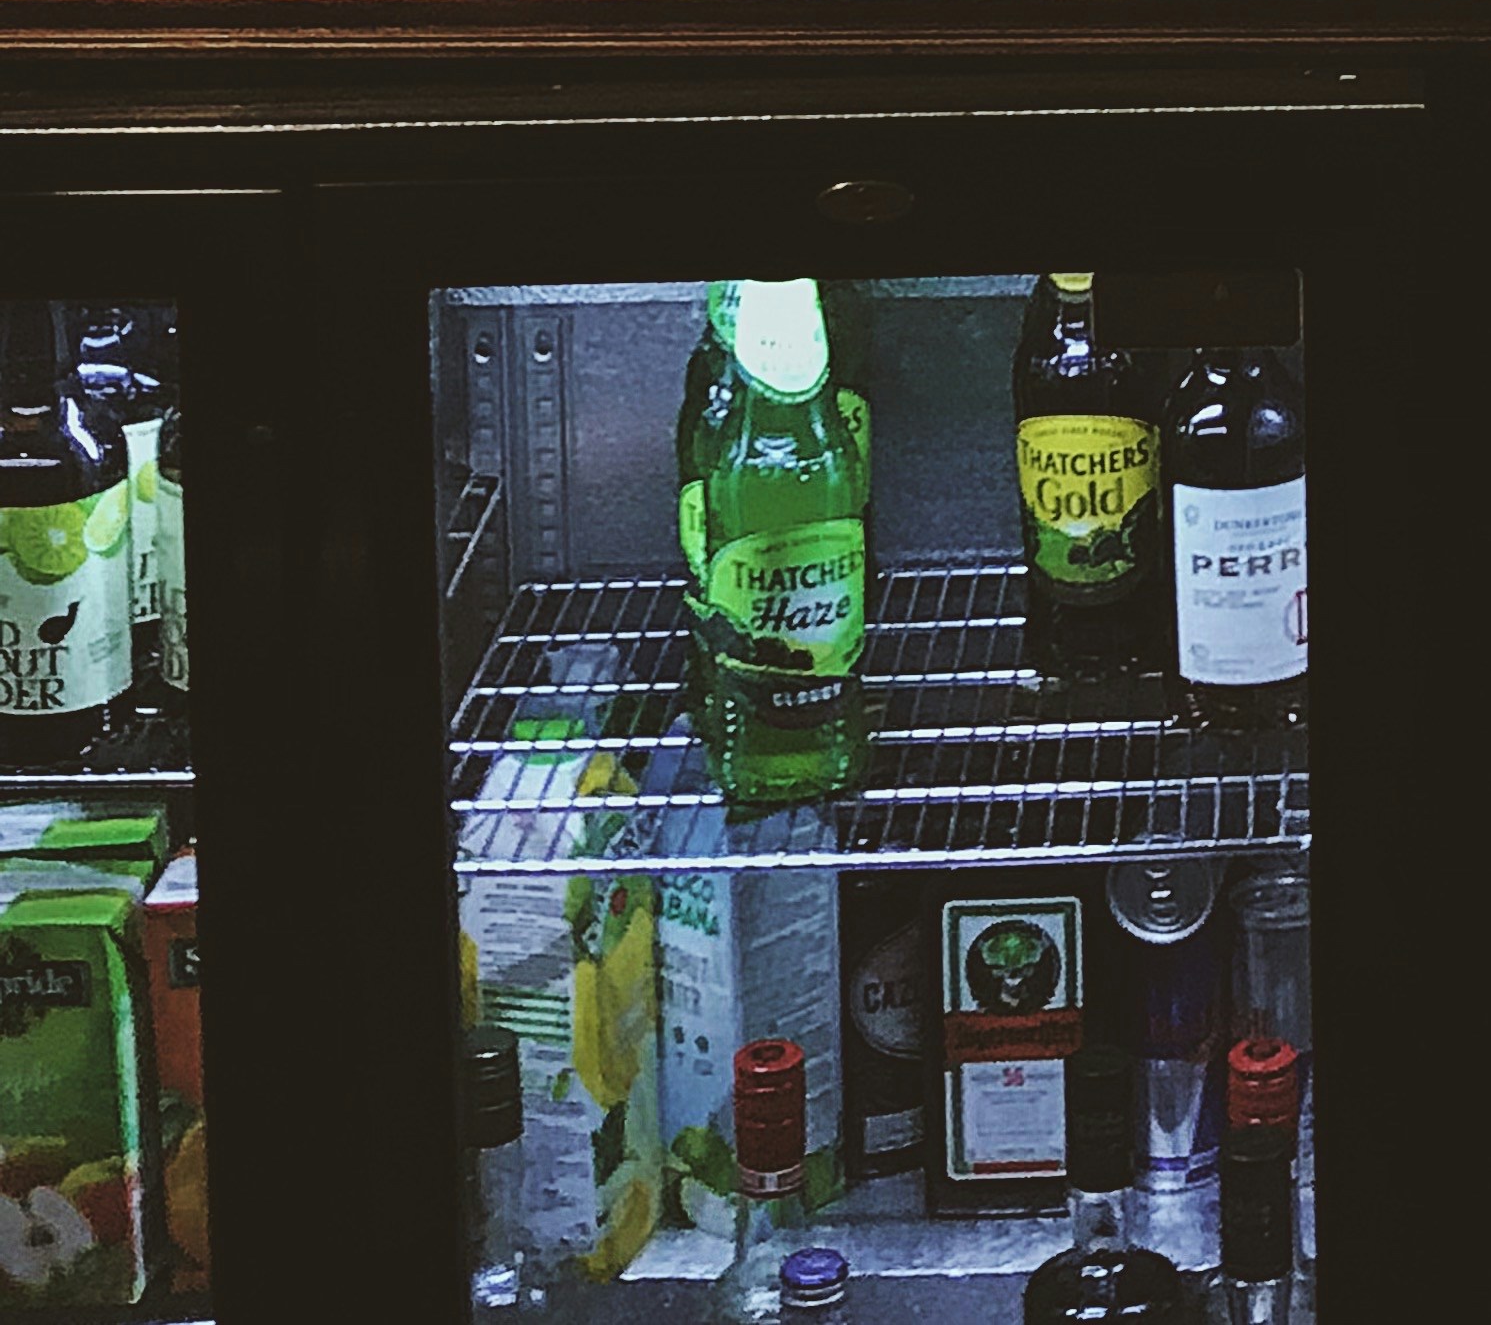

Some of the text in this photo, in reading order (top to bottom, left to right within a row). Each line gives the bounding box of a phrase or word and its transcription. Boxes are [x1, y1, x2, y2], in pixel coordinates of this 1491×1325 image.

[1018, 437, 1150, 477] THATCHERS
[1035, 476, 1124, 522] Gold
[750, 594, 851, 632] Haze
